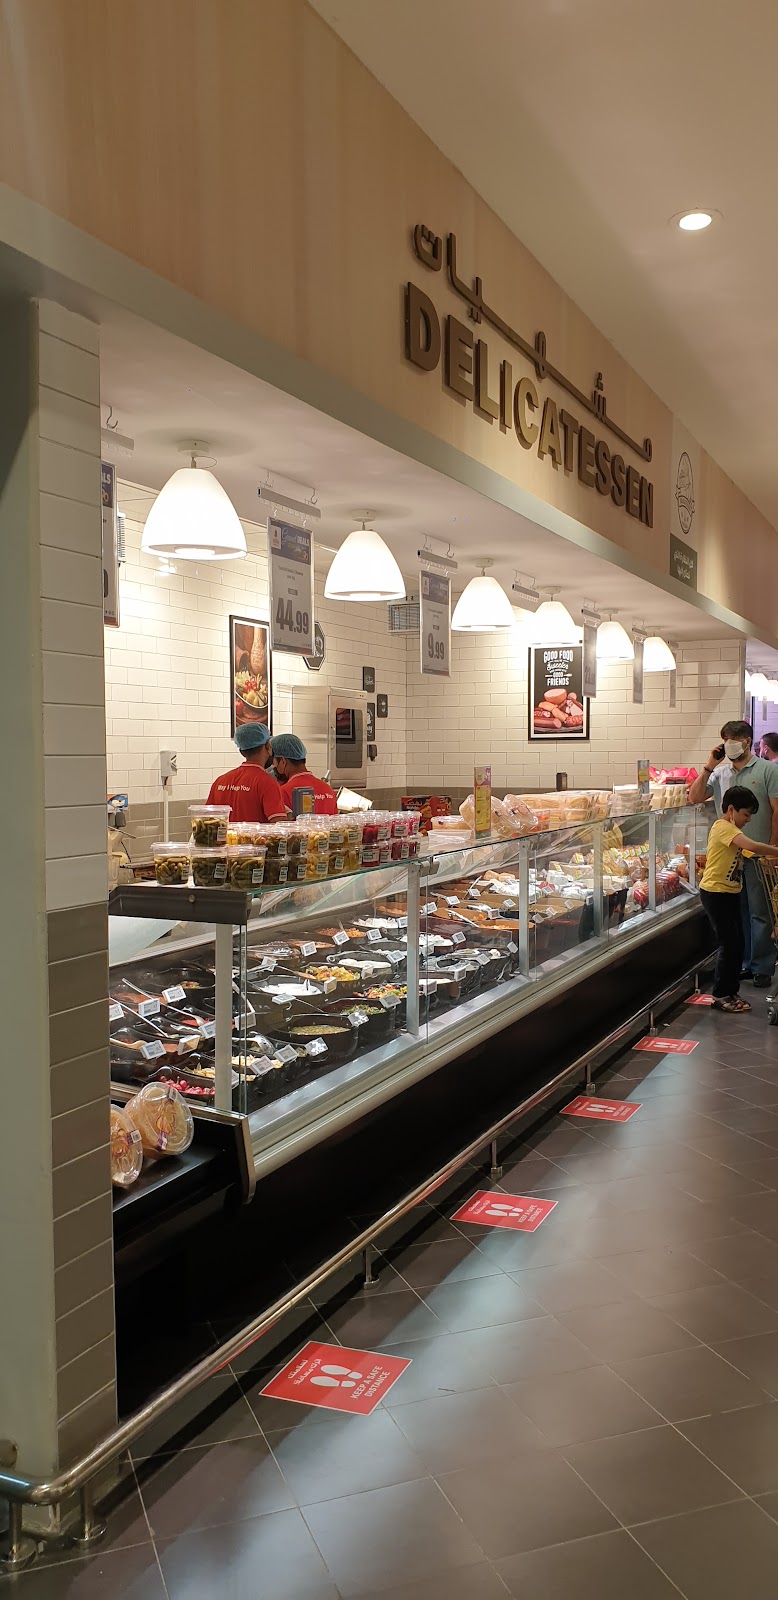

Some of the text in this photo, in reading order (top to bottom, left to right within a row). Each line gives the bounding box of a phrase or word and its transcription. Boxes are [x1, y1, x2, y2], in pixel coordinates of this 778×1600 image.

[405, 281, 653, 528] DELICATESSEN
[276, 597, 309, 634] 44.99
[428, 633, 444, 660] 9.99
[544, 650, 573, 663] GOOD FOOD
[547, 678, 569, 686] FRIENDS
[240, 784, 251, 792] You
[350, 1365, 384, 1399] KEEP A SAFE
[364, 1371, 391, 1398] DISTANCE
